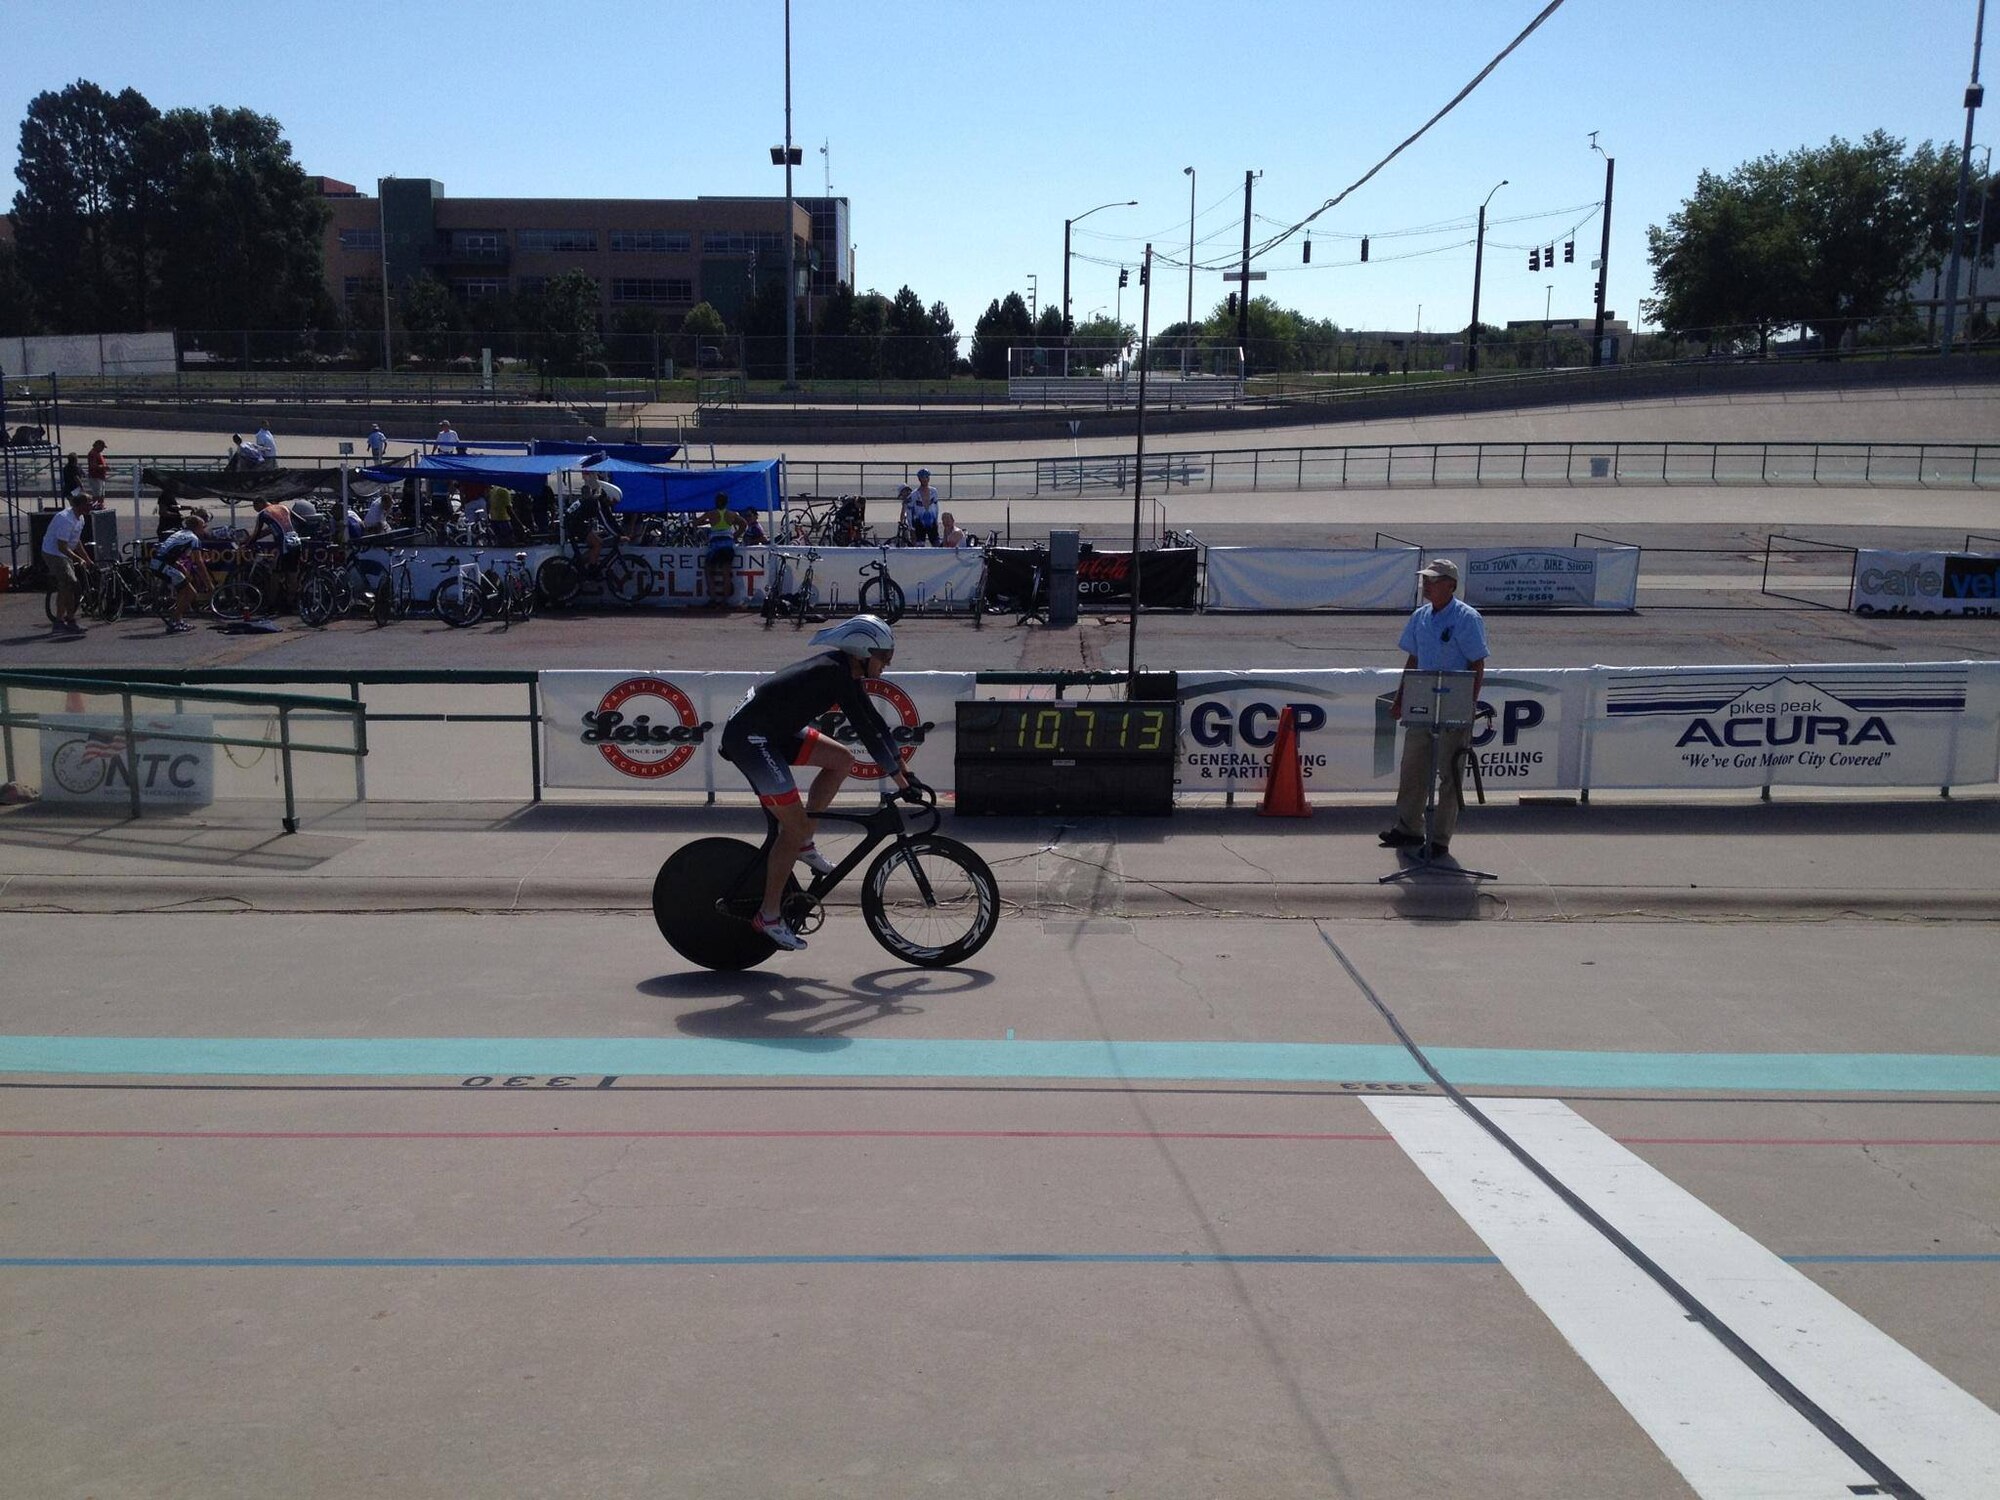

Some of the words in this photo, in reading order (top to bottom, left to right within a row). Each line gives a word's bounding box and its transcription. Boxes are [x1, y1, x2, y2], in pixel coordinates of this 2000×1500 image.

[1493, 559, 1518, 571] TOWN
[1544, 559, 1564, 571] BIKE
[1567, 562, 1591, 571] SHOP
[1078, 580, 1115, 593] ero.
[1861, 562, 1942, 597] cafe
[604, 682, 679, 709] PAINTING
[1730, 701, 1776, 717] pikes
[1780, 699, 1823, 716] peak
[580, 710, 714, 745] Leiser
[1675, 715, 1897, 748] ACURA
[604, 747, 688, 774] DECORATING
[1188, 753, 1260, 766] GENERAL
[1480, 752, 1543, 765] CEILING
[1733, 752, 1757, 768] Got
[1760, 752, 1795, 768] Motor
[1797, 750, 1826, 769] City
[1201, 766, 1213, 779] &
[1219, 766, 1313, 779] PARTITS
